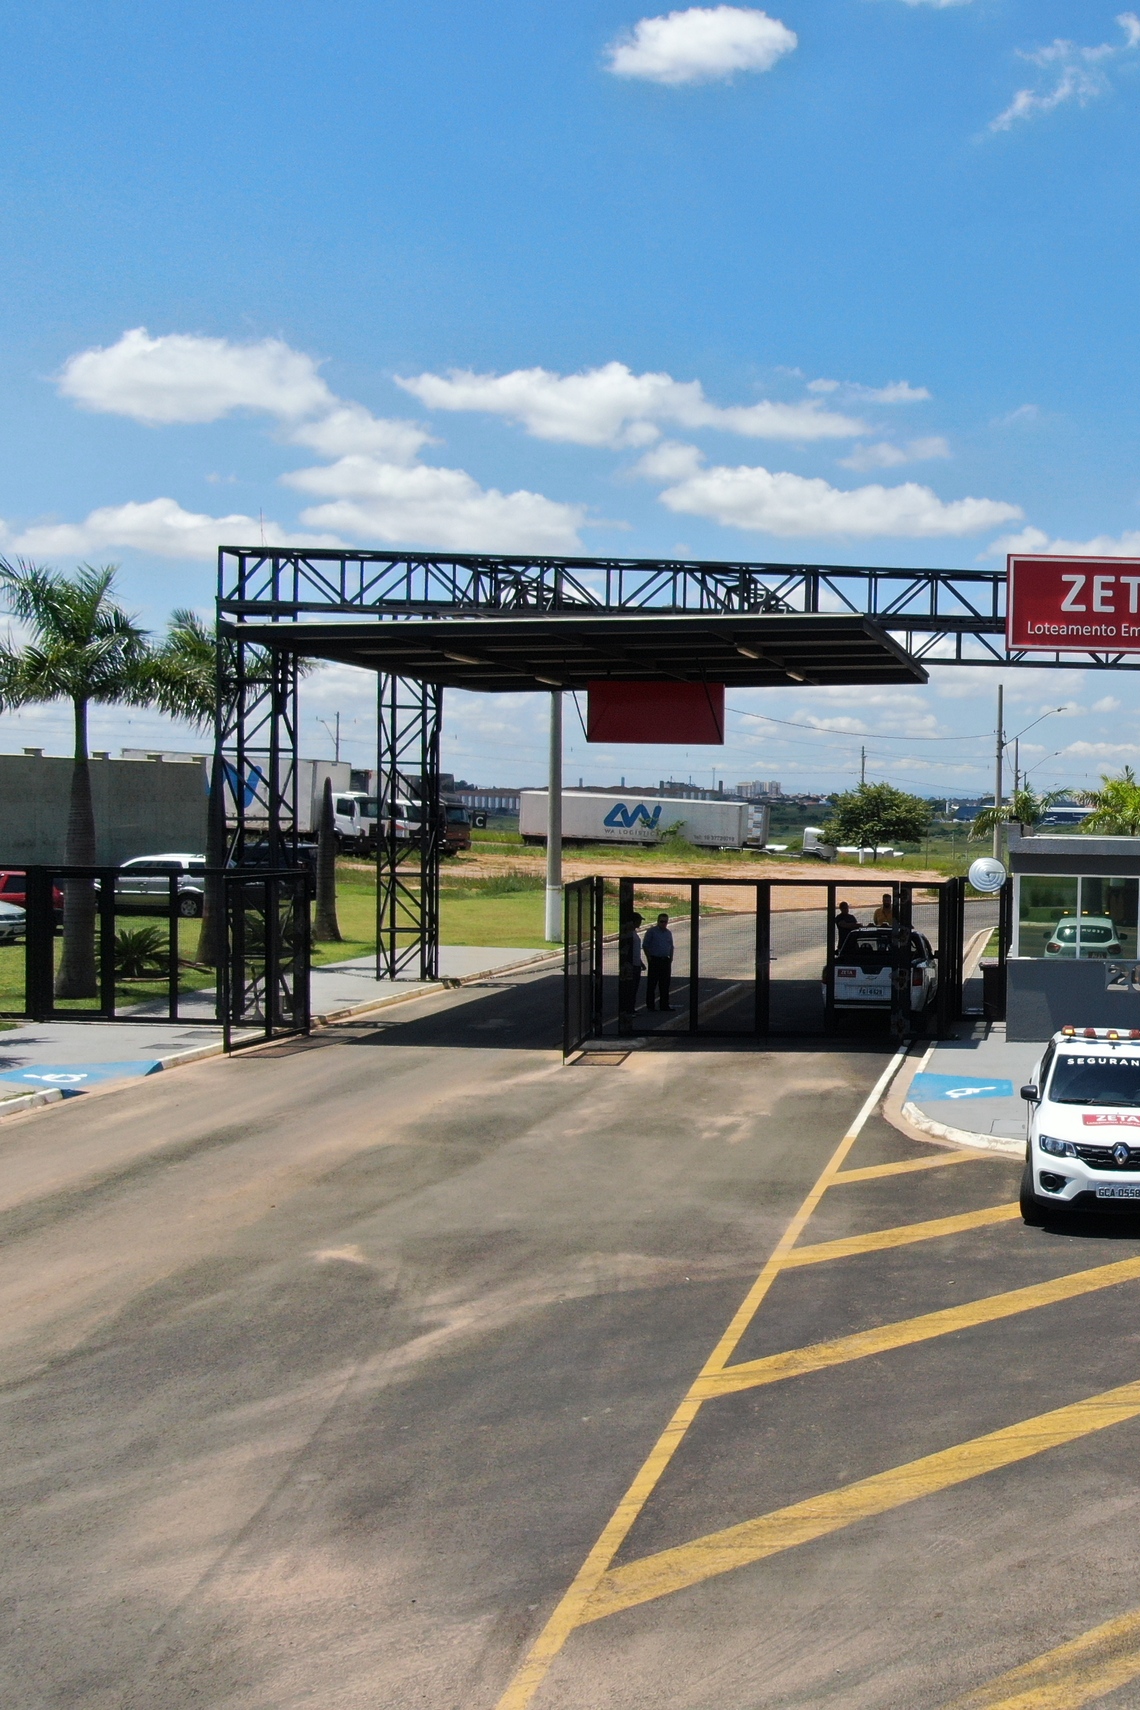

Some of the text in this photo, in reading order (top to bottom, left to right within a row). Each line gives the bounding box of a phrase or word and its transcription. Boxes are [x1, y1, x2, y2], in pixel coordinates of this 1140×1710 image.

[1027, 621, 1116, 637] Loteamento
[475, 816, 484, 827] C
[1096, 1115, 1140, 1123] ZETA
